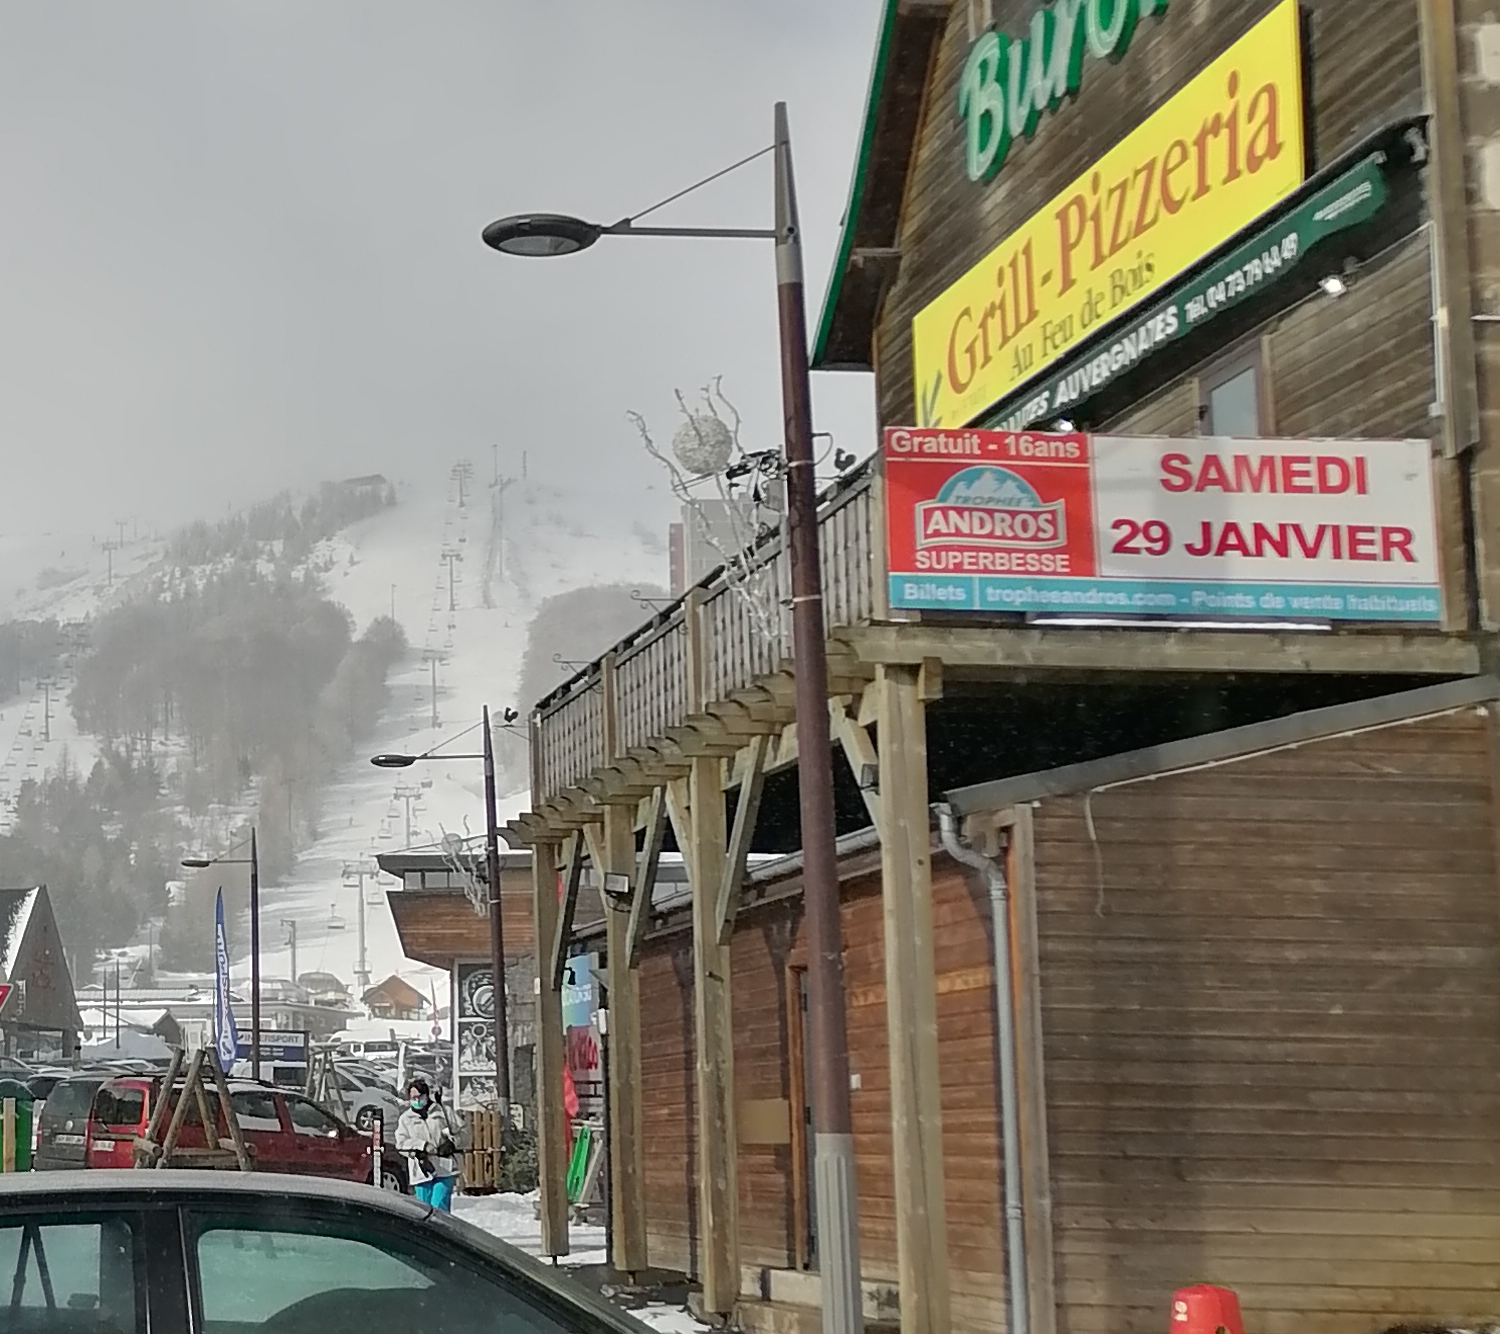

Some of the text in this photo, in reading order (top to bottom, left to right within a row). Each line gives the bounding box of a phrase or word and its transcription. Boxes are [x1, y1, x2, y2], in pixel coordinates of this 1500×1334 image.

[1010, 249, 1155, 382] Au Feu de Bois
[1052, 305, 1179, 409] AUVERGNATES
[890, 431, 981, 455] Gratuit
[1004, 434, 1080, 458] 16ans
[1160, 452, 1368, 496] SAMEDI
[926, 510, 1055, 539] ANDROS
[1111, 518, 1418, 563] 29 JANVIER
[915, 550, 1071, 573] SUPERBESSE
[903, 582, 967, 602] Billets
[1191, 590, 1256, 609] Points
[1259, 591, 1285, 609] de
[1288, 593, 1344, 610] vente
[1346, 594, 1438, 612] habituels
[244, 1033, 300, 1044] INERSPORT
